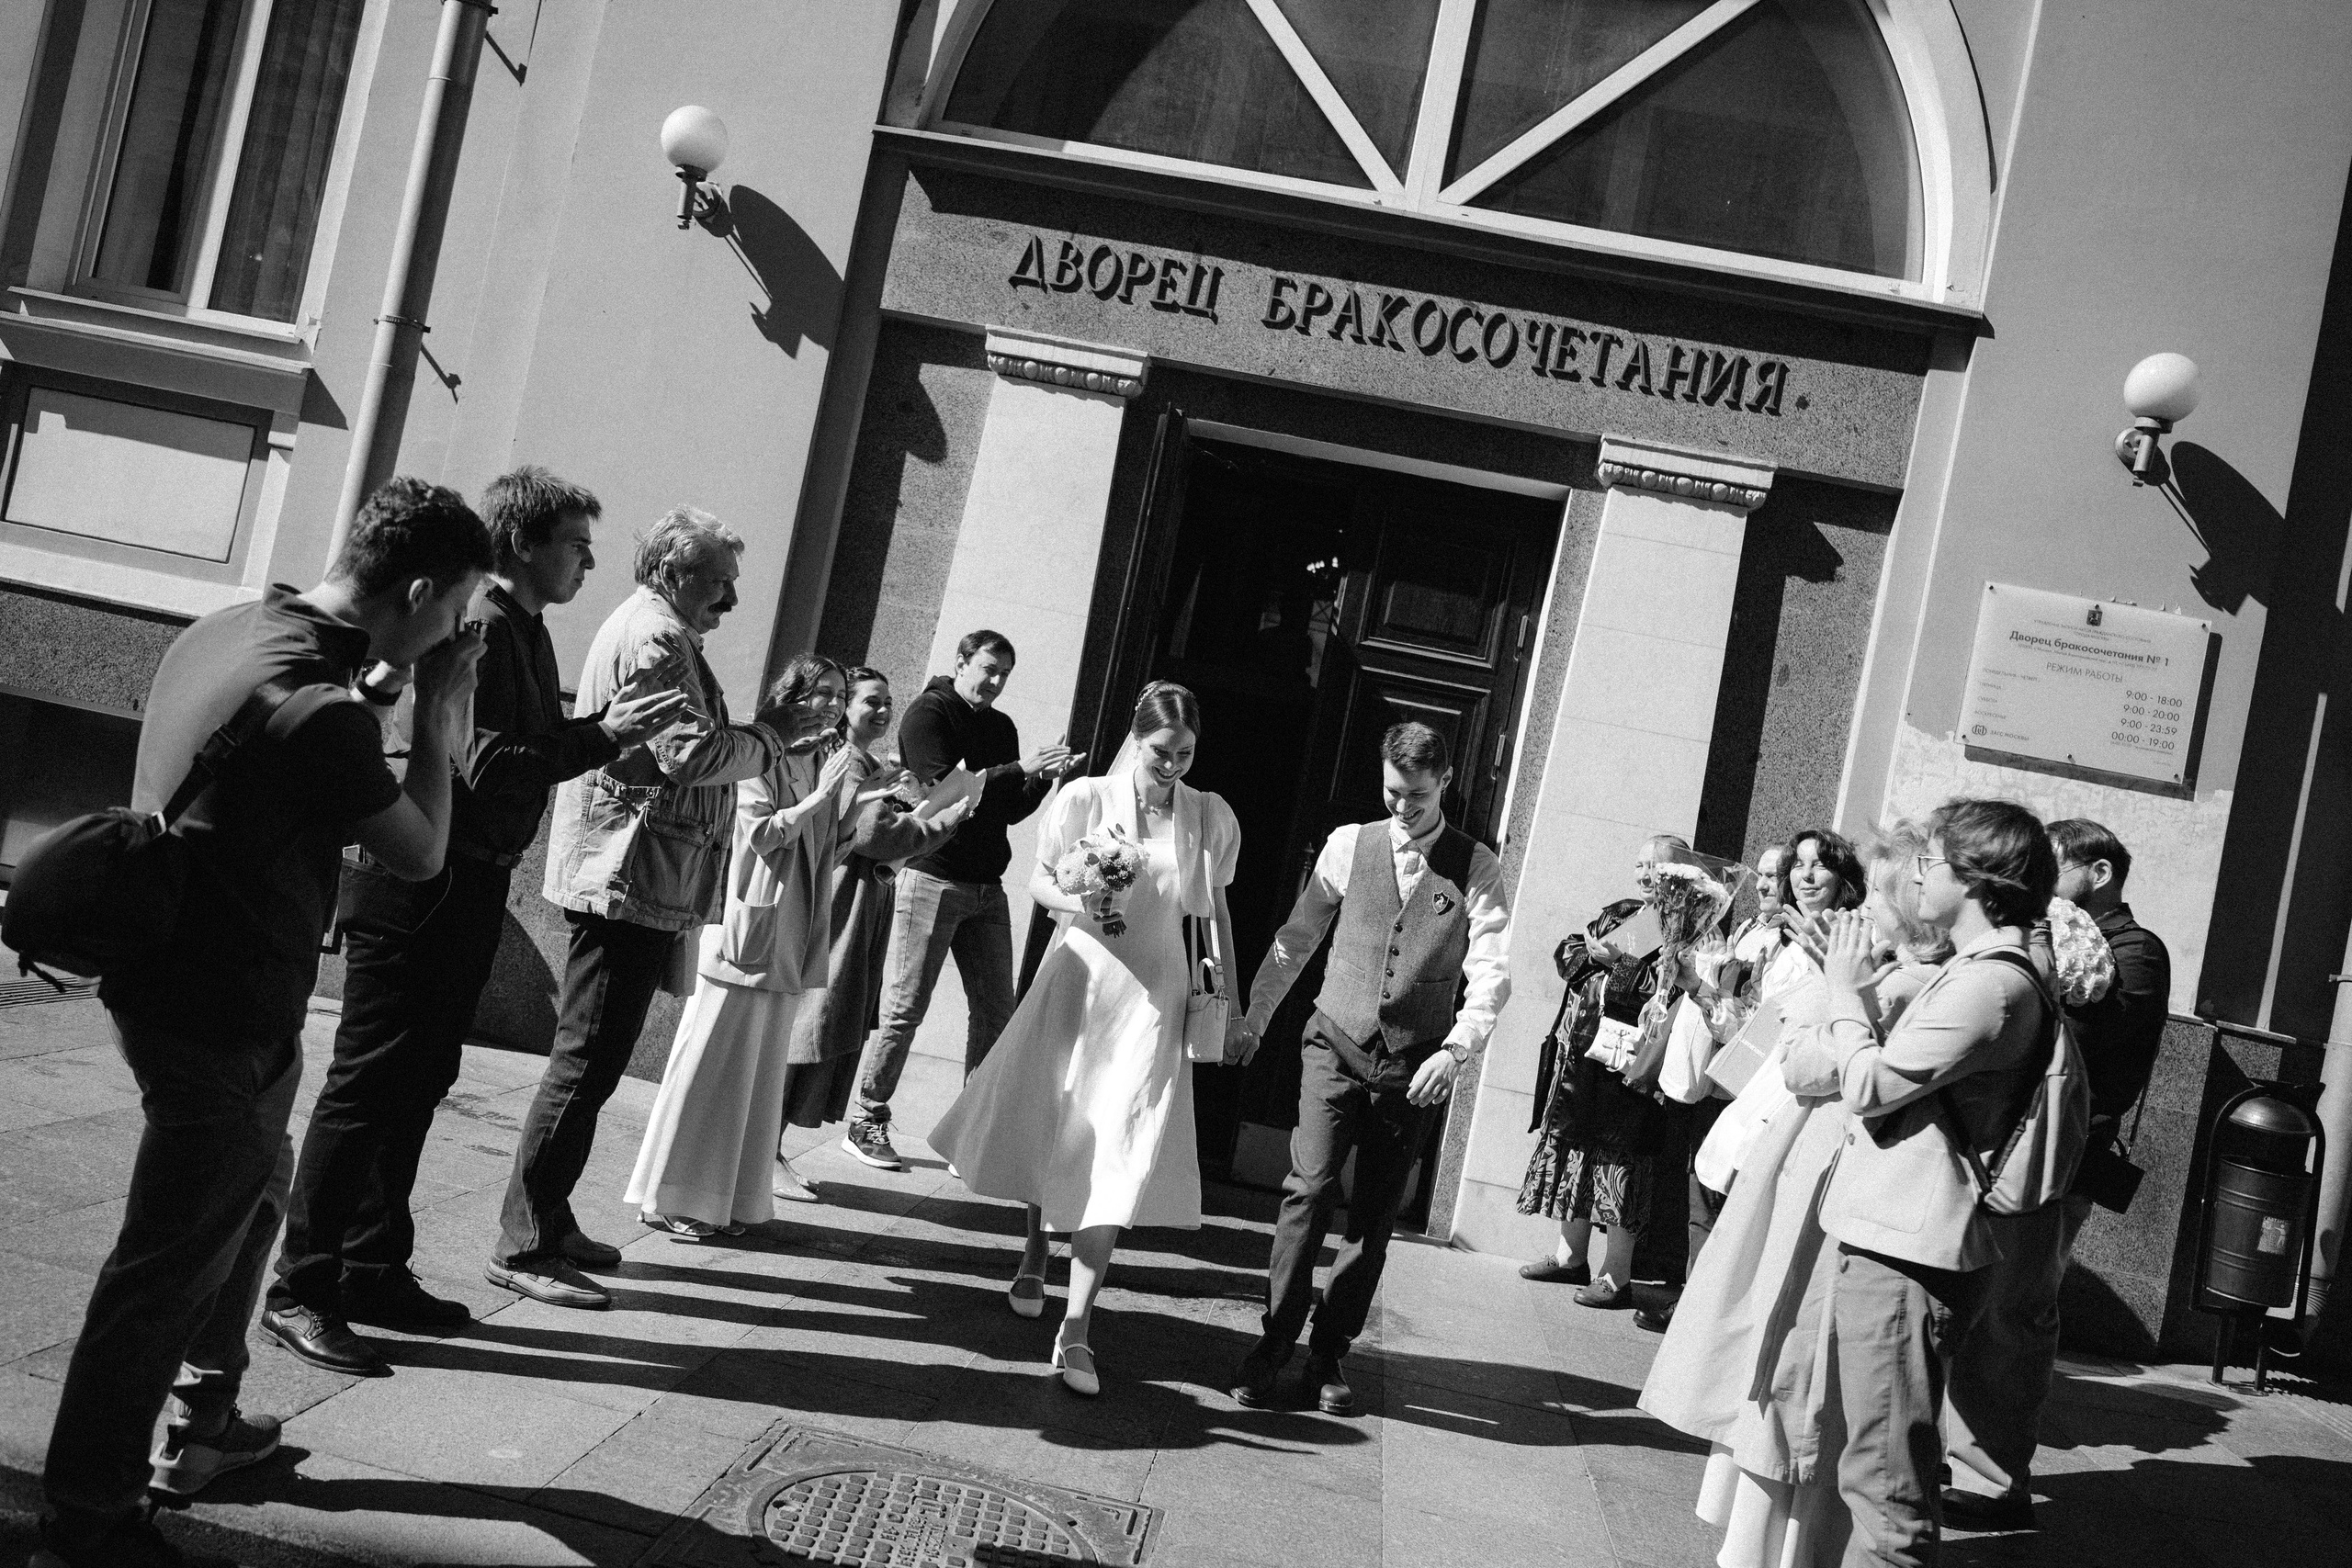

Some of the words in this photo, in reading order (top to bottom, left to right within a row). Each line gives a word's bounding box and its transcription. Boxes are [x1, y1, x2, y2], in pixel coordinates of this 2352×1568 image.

[1010, 234, 1226, 322] ДВОРЕЦ
[1262, 275, 1790, 415] БРАКОСОЧЕТАНИЯ
[2009, 630, 2052, 648] Дворец
[2052, 637, 2143, 663] бракосочетания
[2146, 654, 2160, 665] №
[2164, 658, 2168, 666] 1
[2046, 661, 2082, 675] РЕЖИМ
[2085, 669, 2122, 682] РАБОТЫ
[2125, 689, 2147, 701] 9:00
[2156, 695, 2182, 707] 18:00
[2122, 704, 2145, 715] 9:00
[2152, 709, 2180, 721] 20:00
[2004, 732, 2029, 740] МОСКВЫ
[2120, 717, 2143, 729] 9:00
[2150, 723, 2177, 736] 23:59
[2110, 730, 2140, 743] 00:00
[2148, 737, 2175, 750] 19:00
